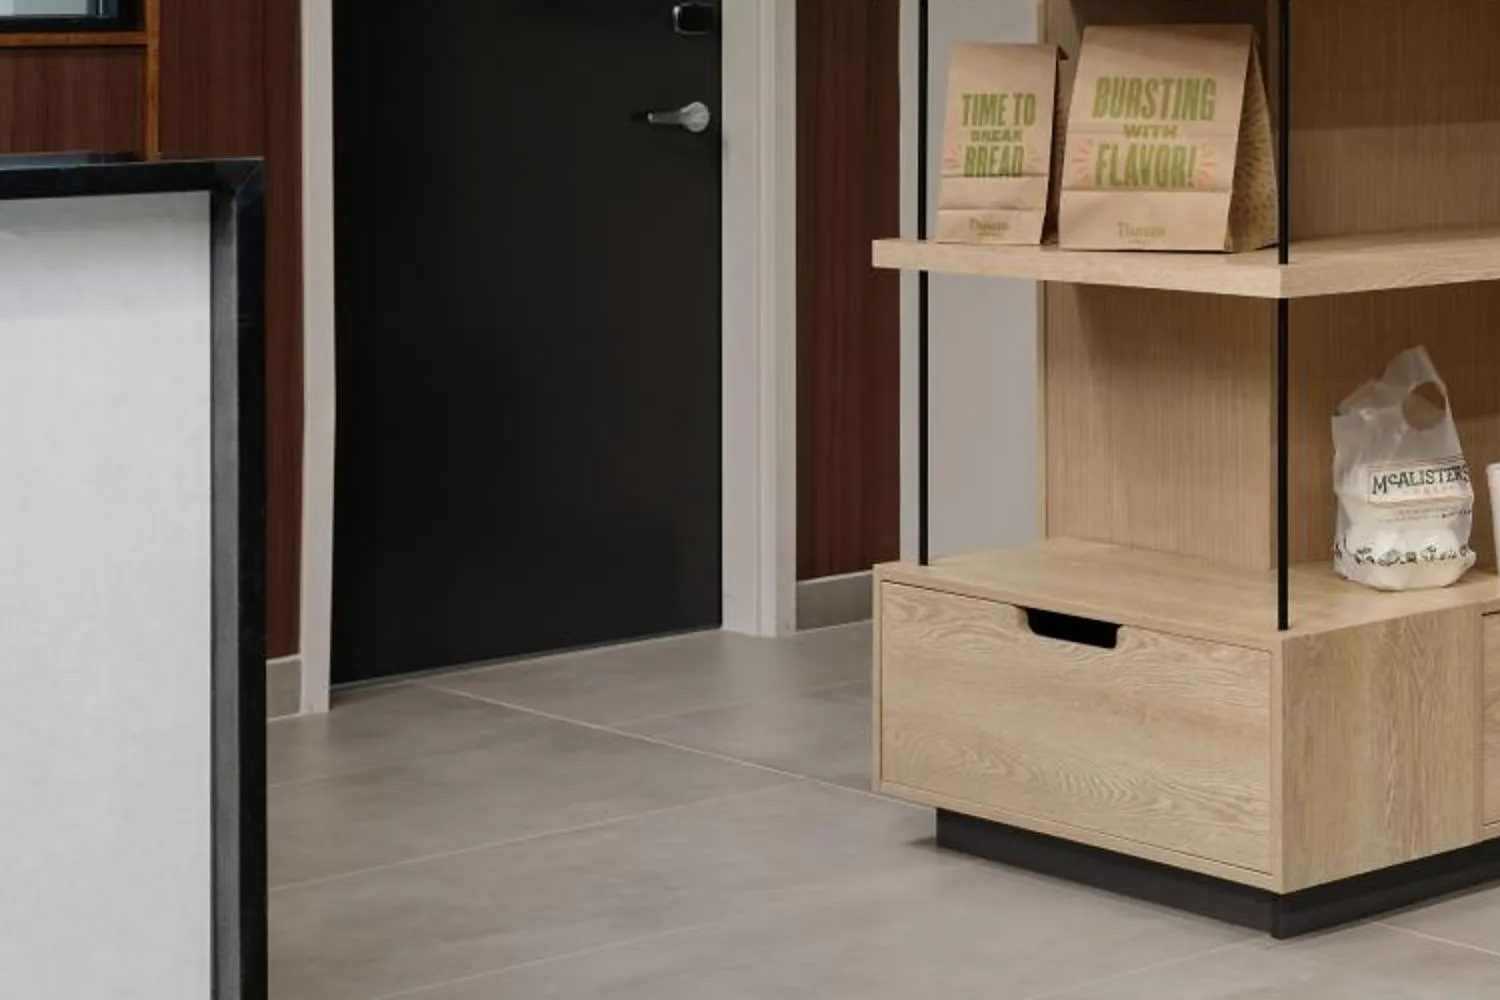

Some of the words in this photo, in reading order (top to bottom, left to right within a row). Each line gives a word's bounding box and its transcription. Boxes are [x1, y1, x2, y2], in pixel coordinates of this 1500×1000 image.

[961, 92, 1008, 128] TIME
[1012, 92, 1036, 128] TO
[1093, 76, 1217, 121] BURSTING
[1123, 124, 1178, 139] WITH
[964, 145, 1024, 178] BREAD
[1096, 144, 1198, 188] FLAVOR!
